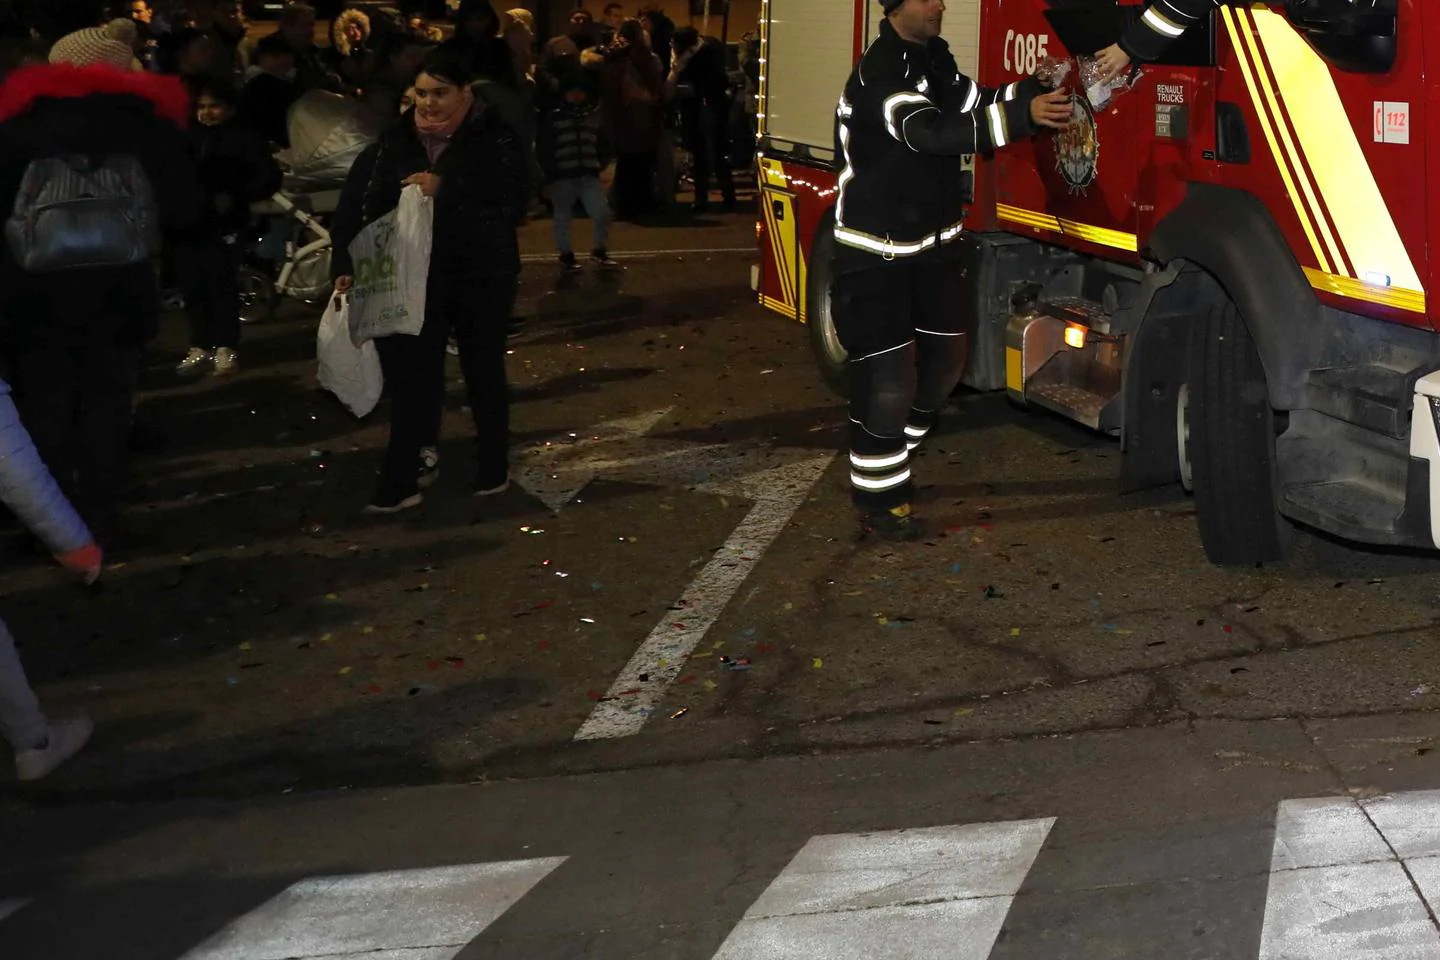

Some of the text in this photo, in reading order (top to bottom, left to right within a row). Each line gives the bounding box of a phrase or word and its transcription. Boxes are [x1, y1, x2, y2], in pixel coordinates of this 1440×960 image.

[1156, 84, 1184, 95] RENAULT
[1157, 93, 1184, 103] TRUCKS
[1386, 112, 1406, 126] 112
